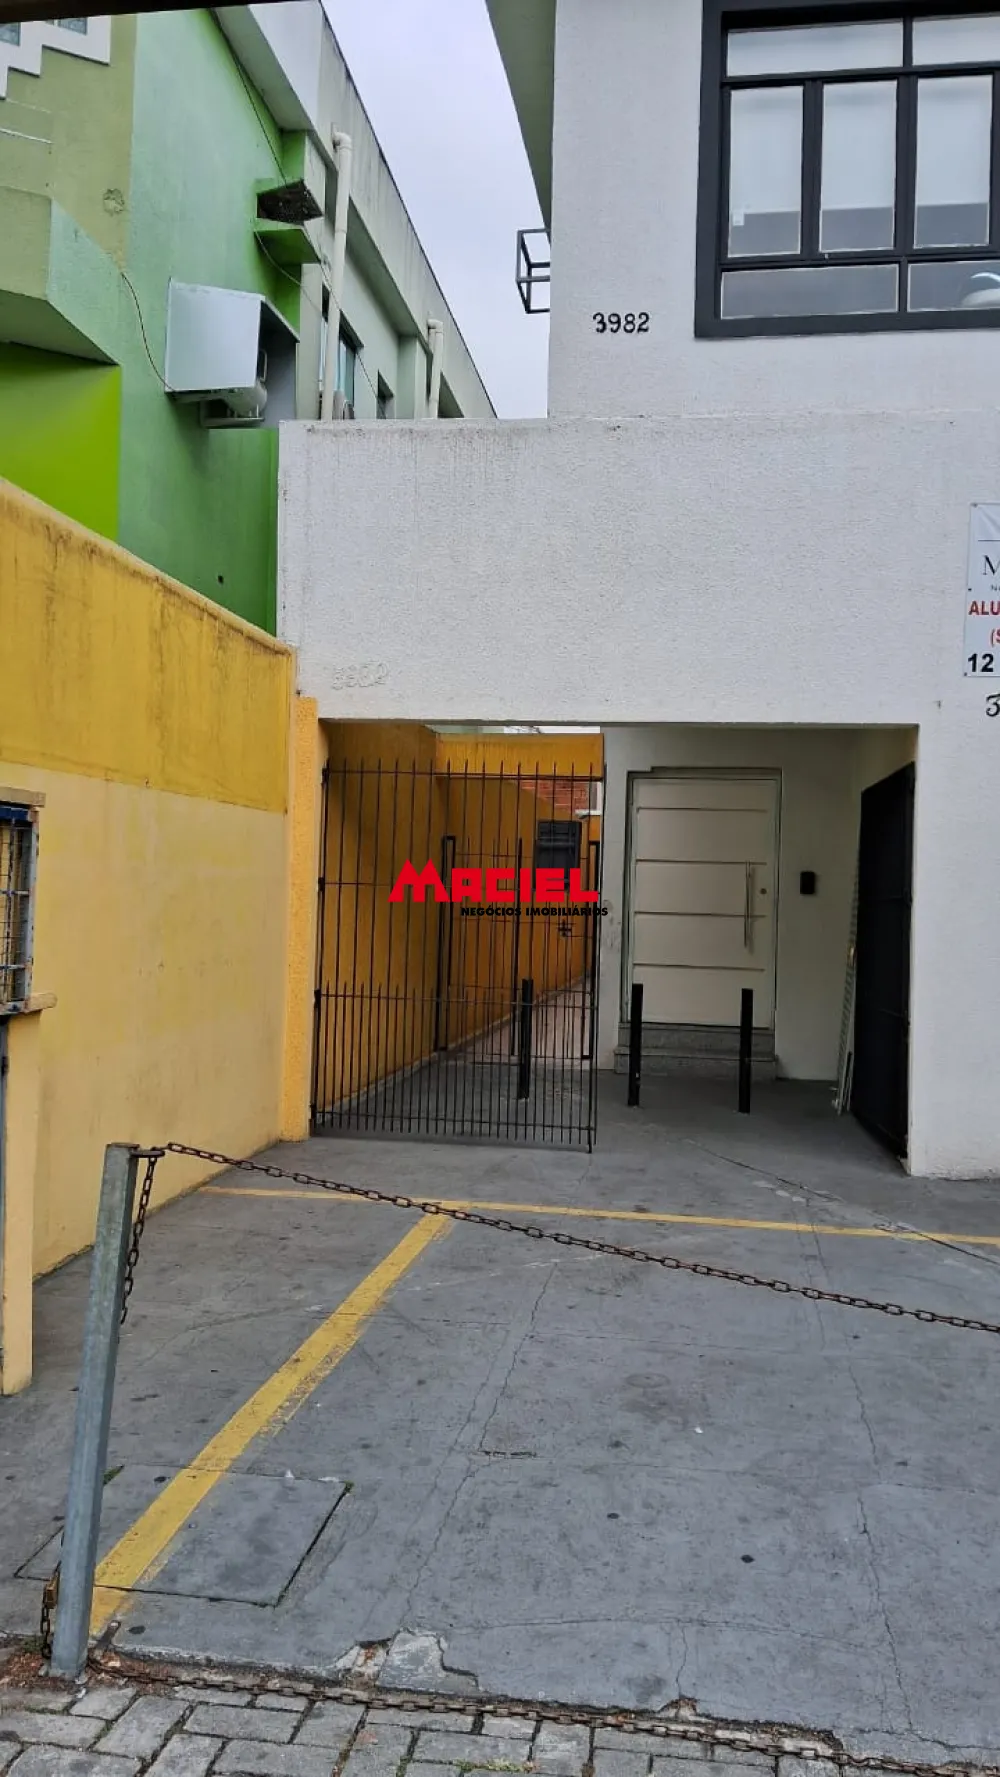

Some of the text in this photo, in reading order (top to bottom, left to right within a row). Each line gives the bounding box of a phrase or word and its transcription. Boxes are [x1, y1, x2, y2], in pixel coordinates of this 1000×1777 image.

[592, 311, 650, 333] 3982
[968, 600, 1000, 616] ALU
[968, 653, 994, 673] 12
[986, 693, 1000, 717] 3
